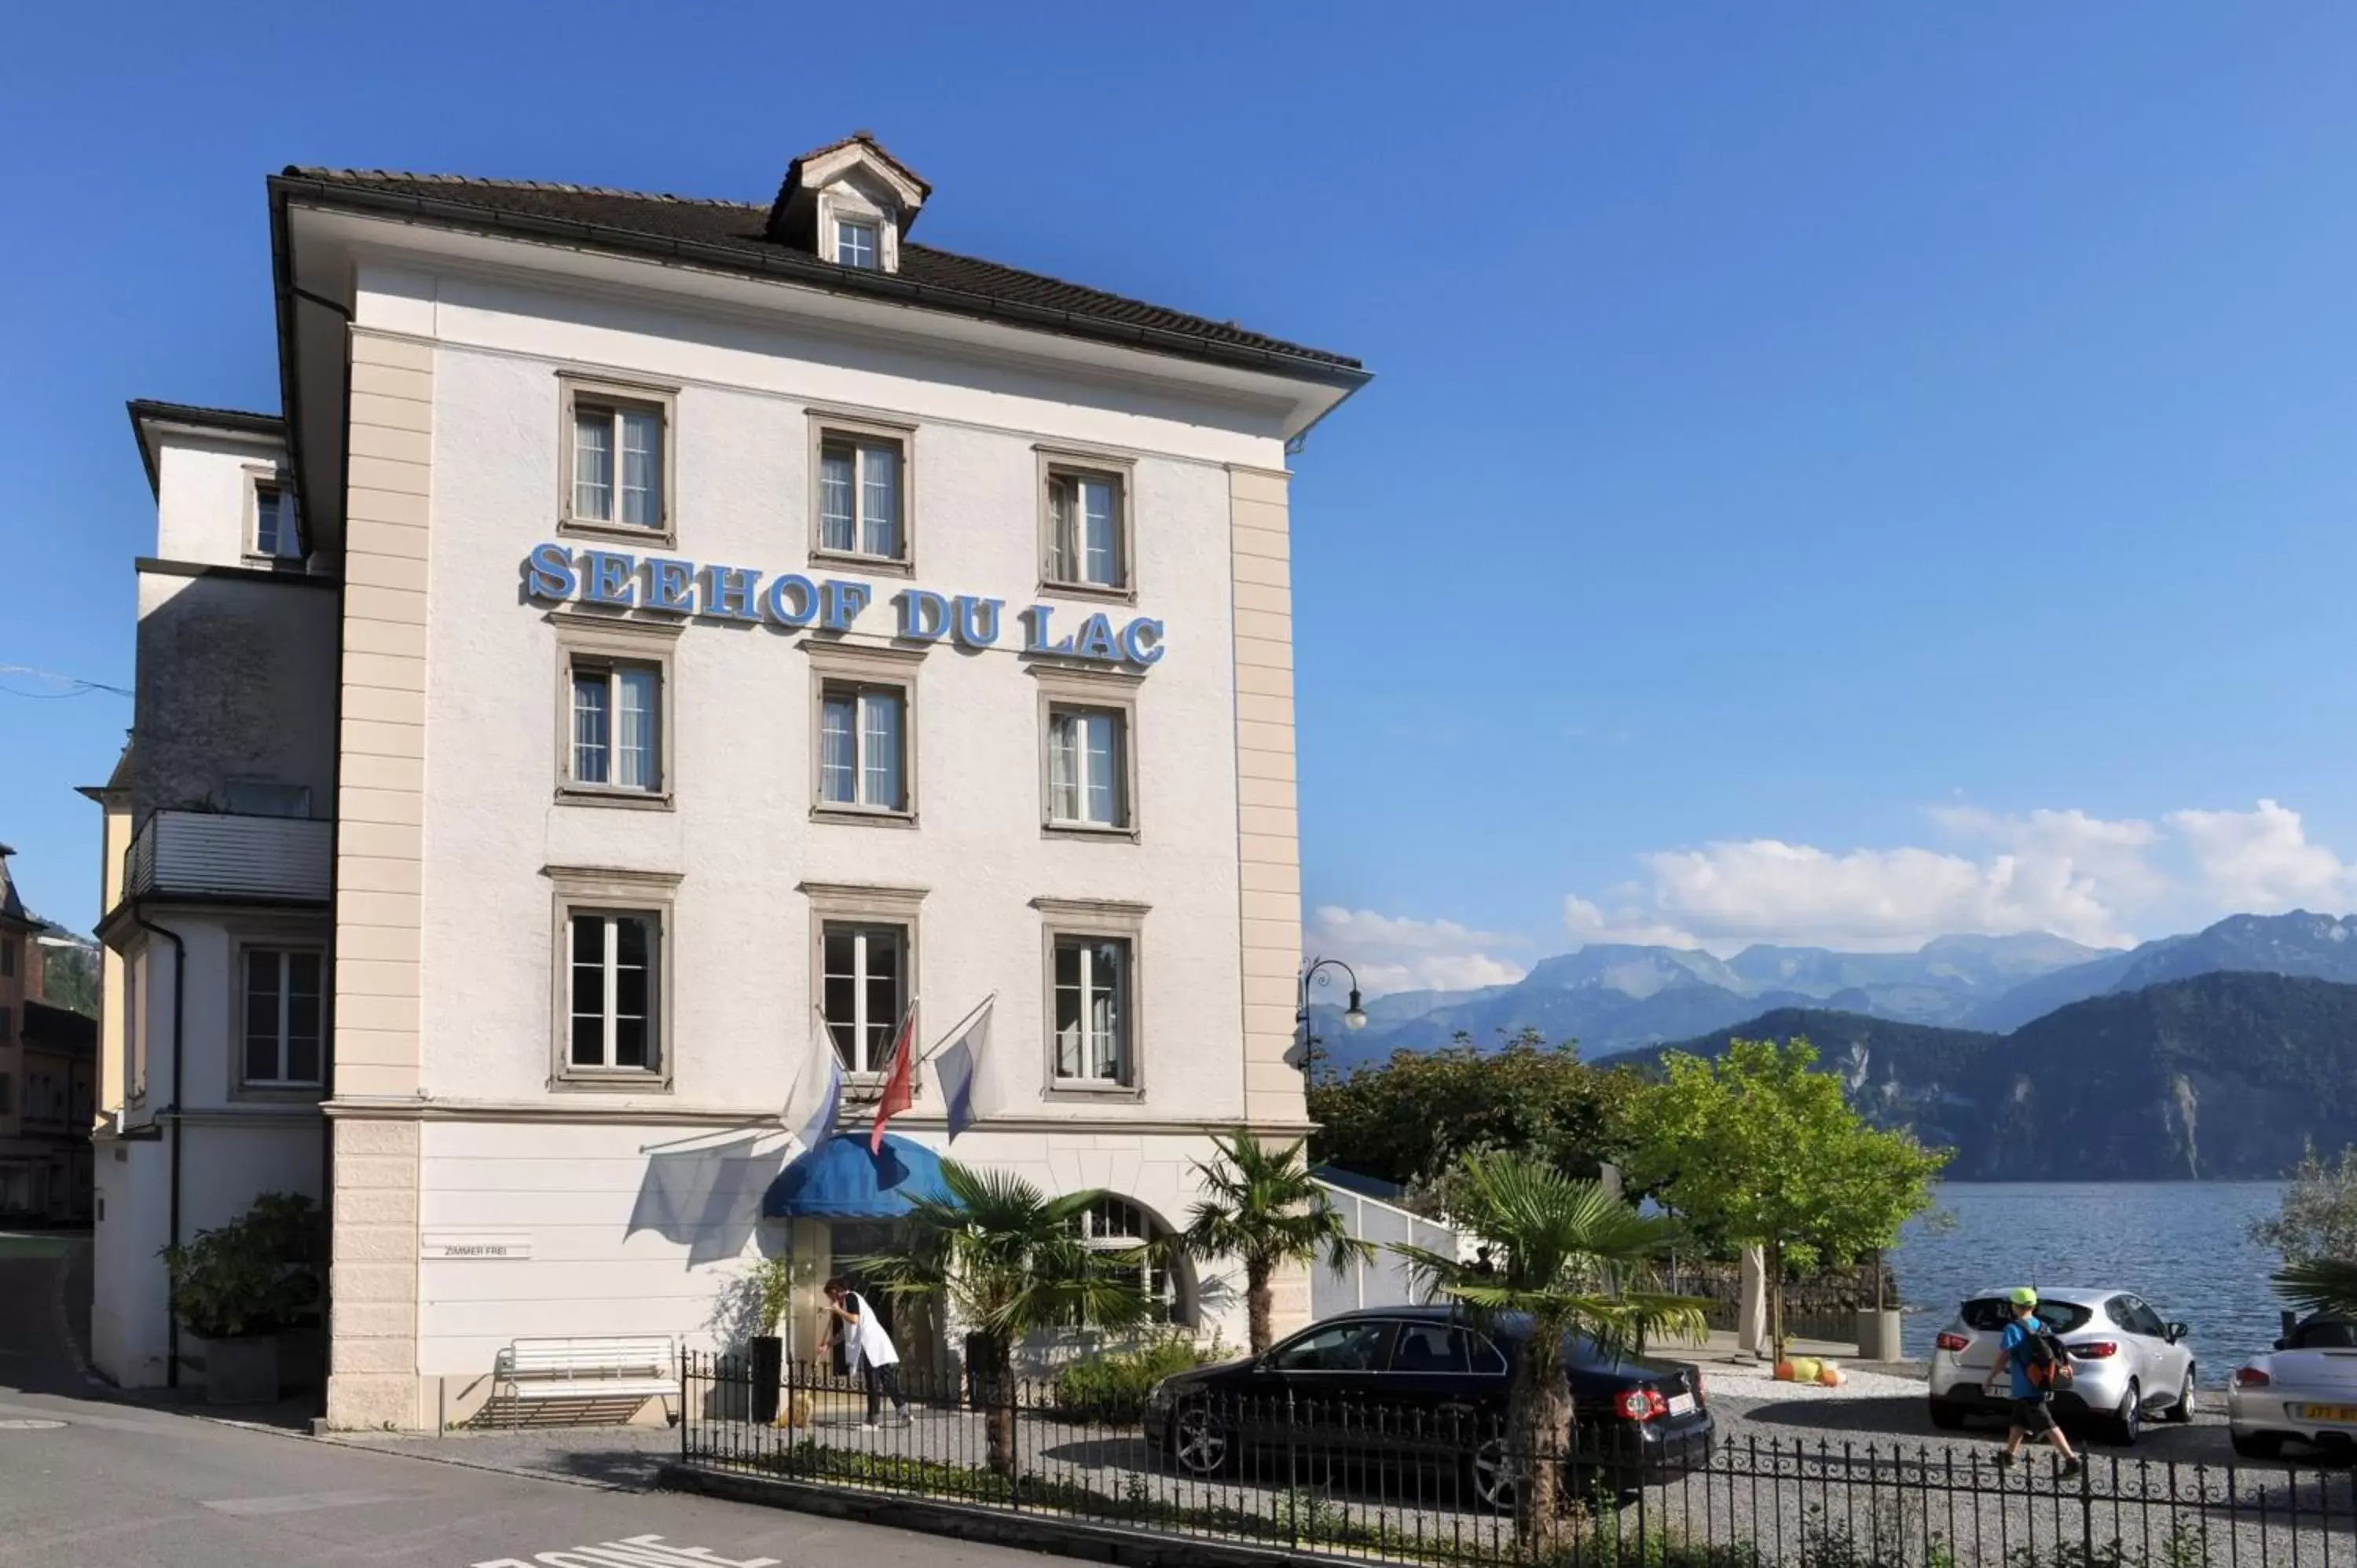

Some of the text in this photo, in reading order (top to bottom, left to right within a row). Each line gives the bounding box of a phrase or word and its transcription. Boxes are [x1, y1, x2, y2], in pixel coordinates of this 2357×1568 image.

[529, 542, 1165, 665] SEEHOF DU LAC
[445, 1245, 507, 1256] ZIMMER FREI
